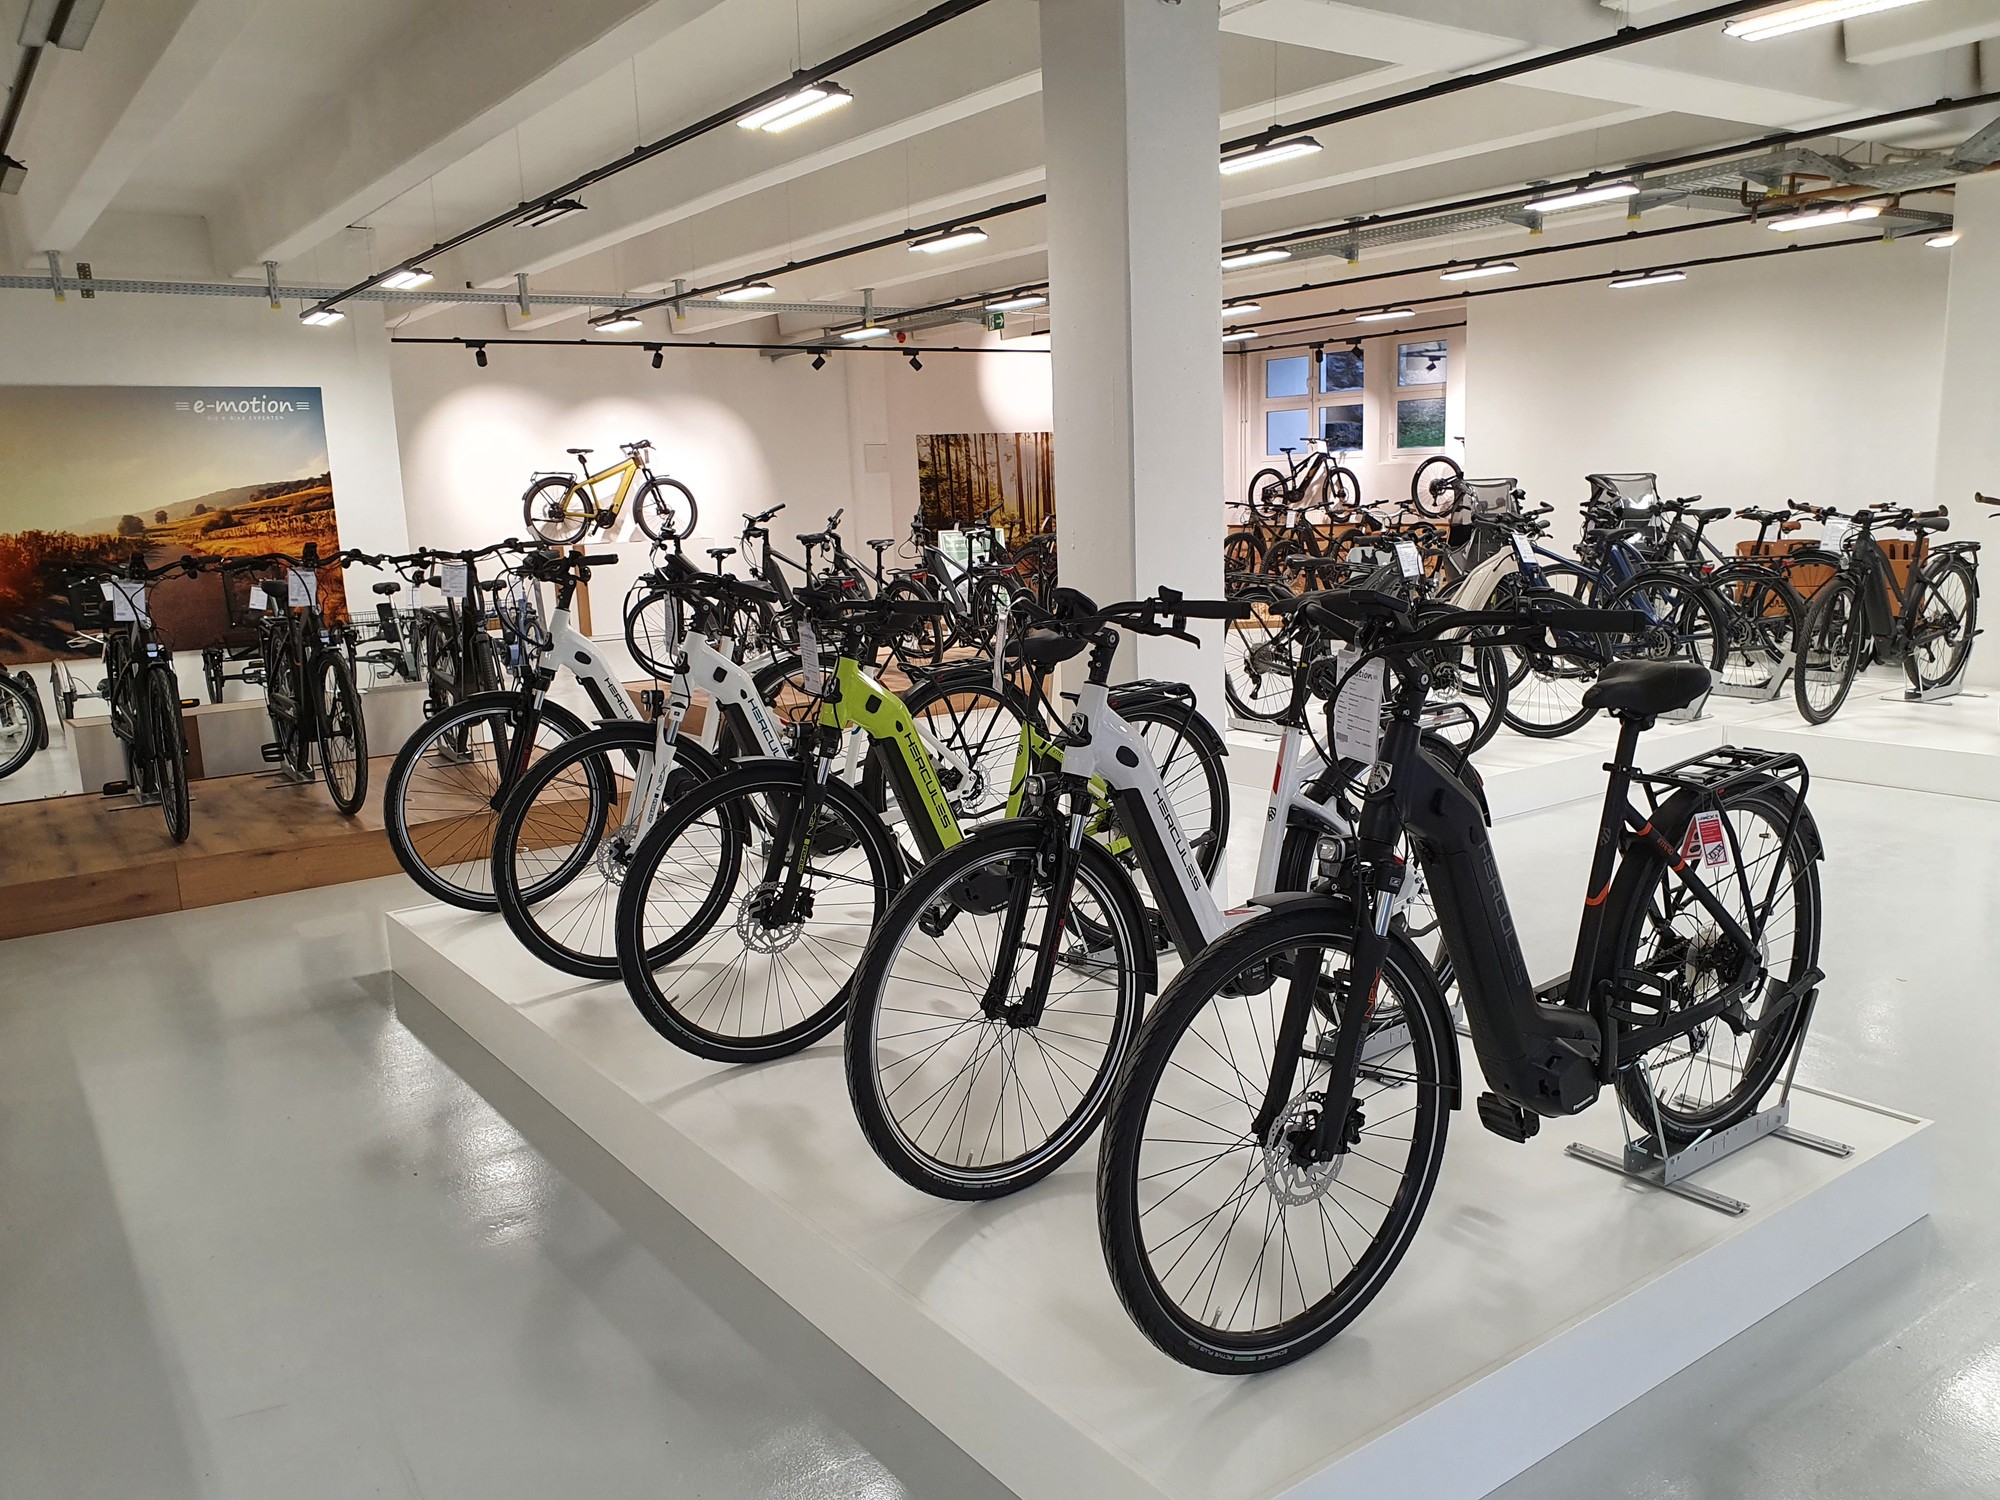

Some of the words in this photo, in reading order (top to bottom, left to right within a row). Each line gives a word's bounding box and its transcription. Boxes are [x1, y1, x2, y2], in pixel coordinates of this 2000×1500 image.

[193, 394, 294, 414] e-motion
[603, 676, 634, 721] HERCU
[747, 697, 781, 758] HERCUL
[904, 732, 952, 829] HERCULES
[1152, 787, 1202, 892] HERCULES
[1477, 839, 1528, 986] HERCULES
